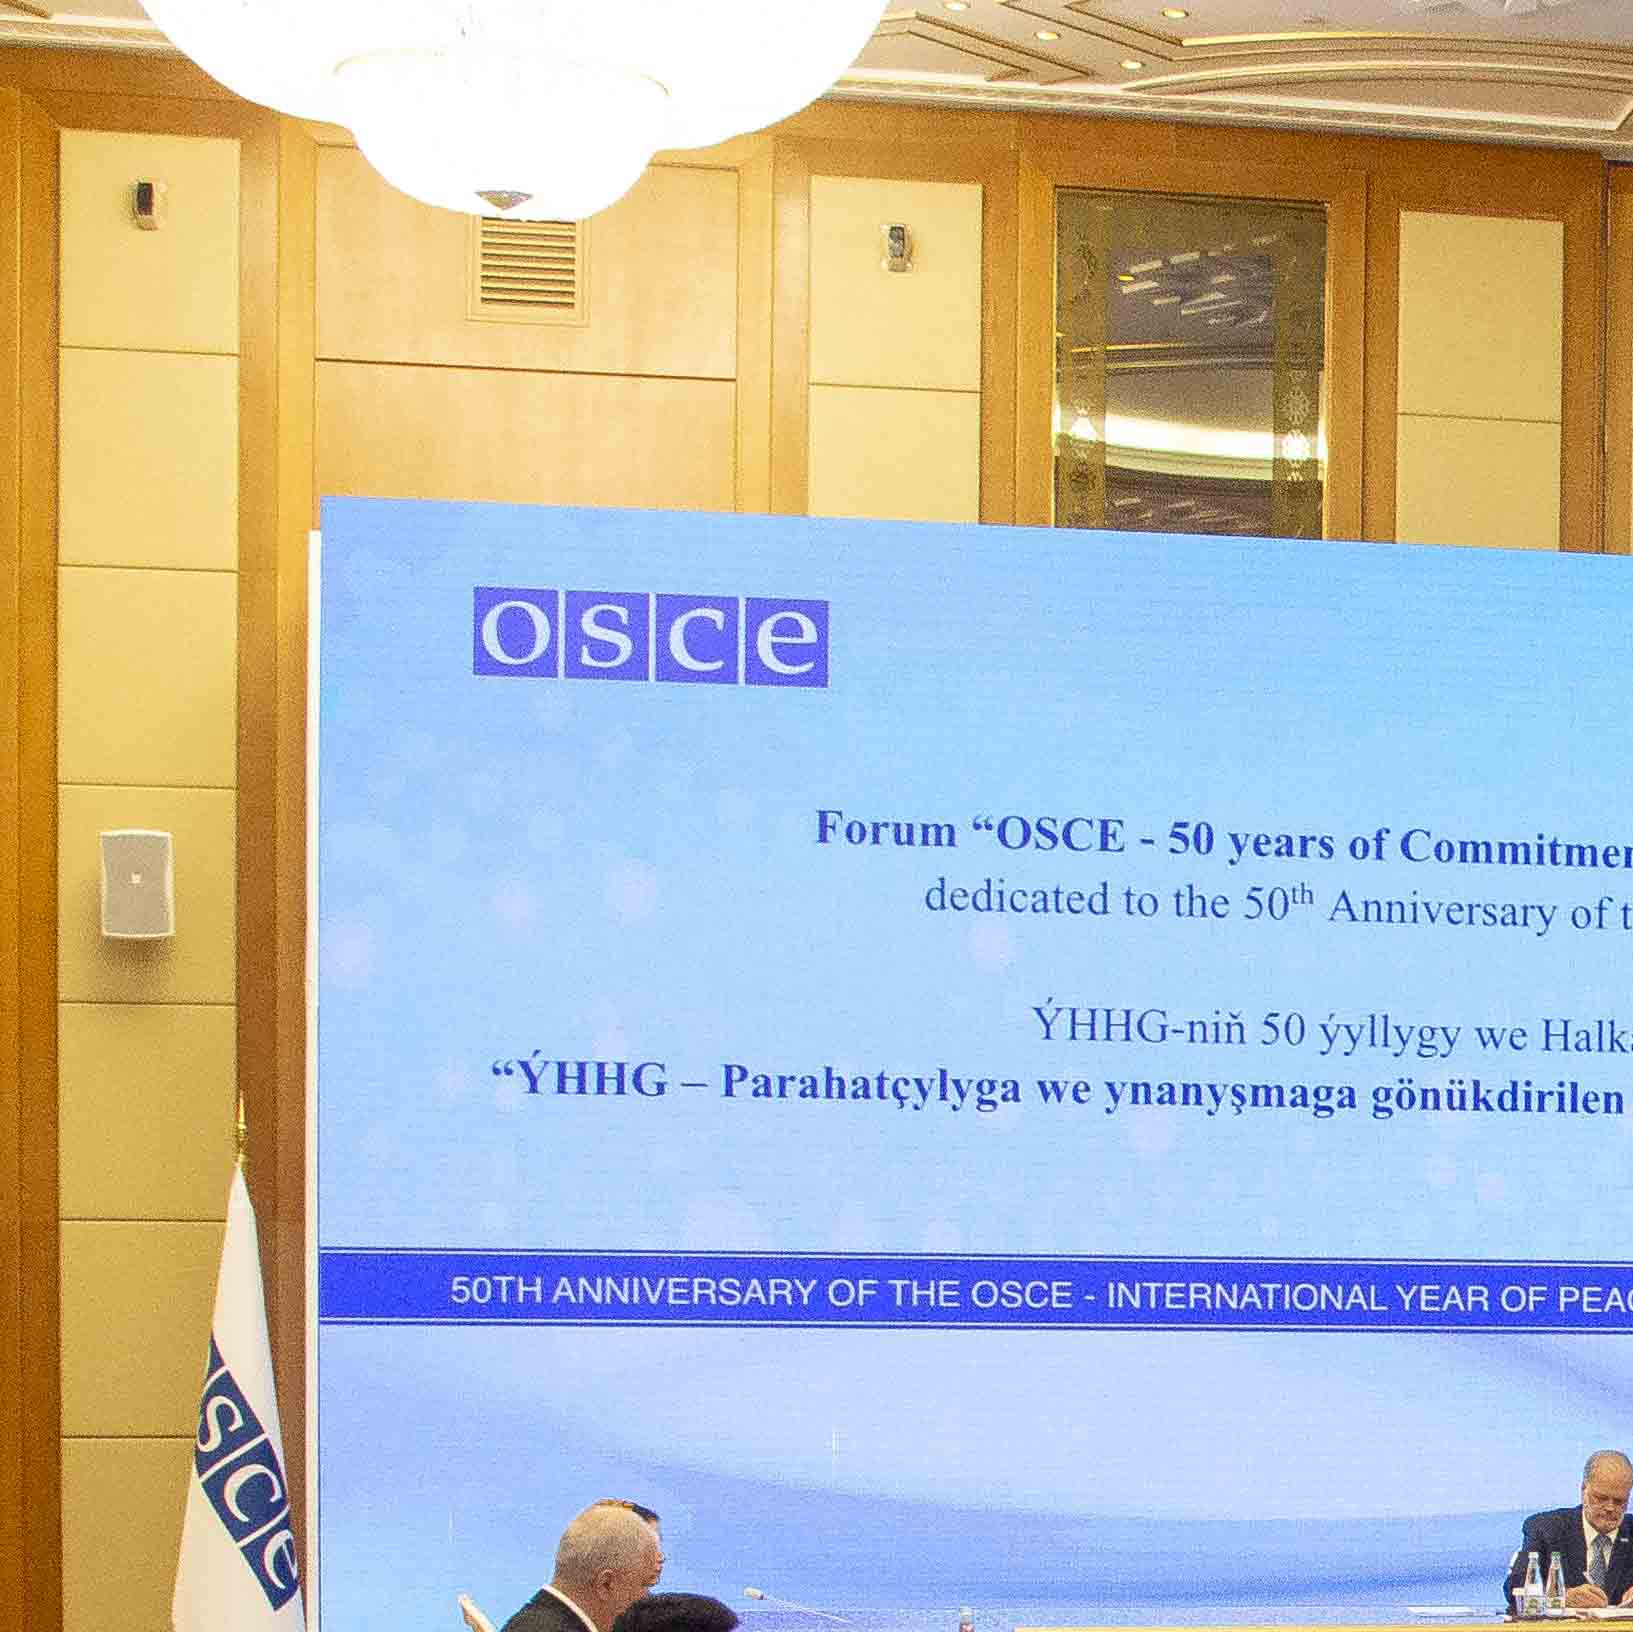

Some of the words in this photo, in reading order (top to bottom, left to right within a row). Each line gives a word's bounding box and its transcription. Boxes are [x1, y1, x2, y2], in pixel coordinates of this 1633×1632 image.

[816, 809, 956, 848] Forum
[1168, 821, 1214, 855] 50
[1228, 832, 1335, 866] years
[1348, 827, 1391, 861] of
[924, 876, 1110, 916] dedicated
[1123, 888, 1159, 917] to
[1173, 883, 1230, 919] the
[1328, 889, 1558, 938] Anniversary
[1570, 896, 1614, 930] of
[1032, 996, 1246, 1045] ÝHHG-niň
[1261, 1011, 1306, 1046] 50
[1319, 1013, 1461, 1059] ýyllygy
[1474, 1026, 1528, 1052] we
[491, 1049, 668, 1097] “ÝHHG
[722, 1063, 1021, 1112] Parahatçylyga
[1036, 1079, 1091, 1105] we
[1104, 1081, 1357, 1118] ynanyşmaga
[1371, 1077, 1624, 1120] gönükdirilen
[451, 1276, 542, 1303] 50TH
[552, 1277, 817, 1305] ANNIVERSARY
[828, 1279, 876, 1306] OF
[889, 1280, 959, 1307] THE
[971, 1280, 1071, 1308] OSCE
[1108, 1282, 1387, 1311] INTERNATIONAL
[1396, 1285, 1489, 1311] YEAR
[1500, 1285, 1547, 1312] OF
